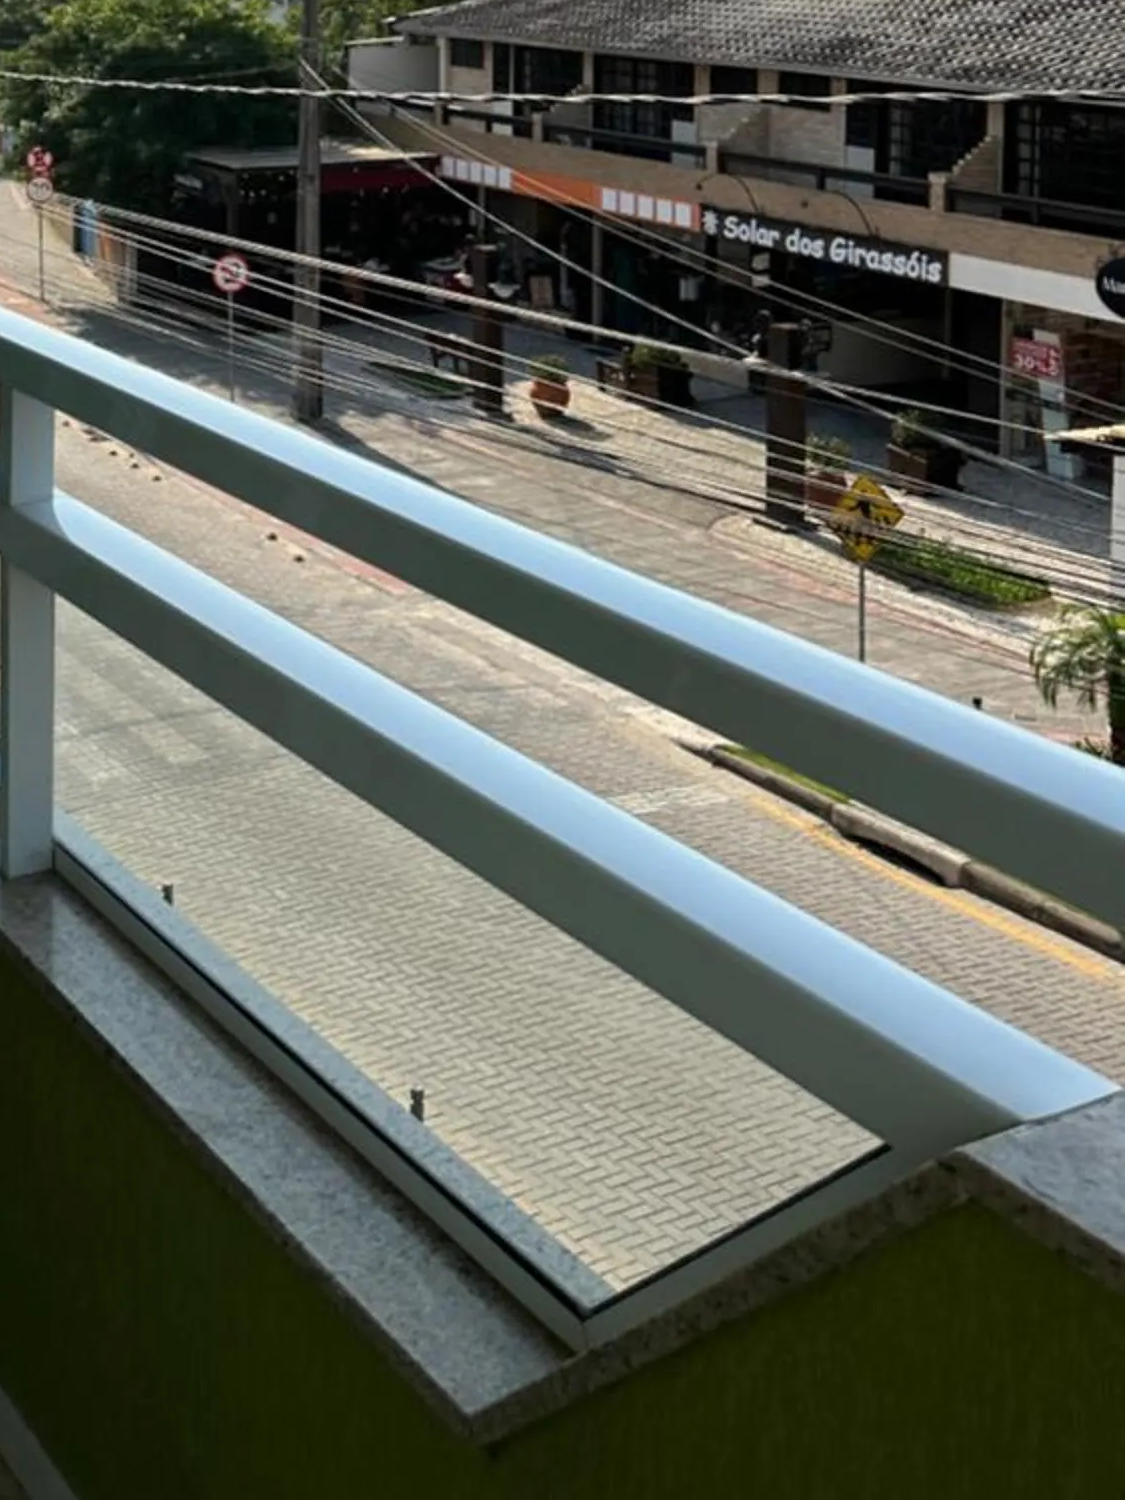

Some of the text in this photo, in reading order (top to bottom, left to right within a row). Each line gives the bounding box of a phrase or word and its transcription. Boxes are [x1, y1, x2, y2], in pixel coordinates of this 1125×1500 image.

[723, 216, 942, 283] Solar dos Girassóis
